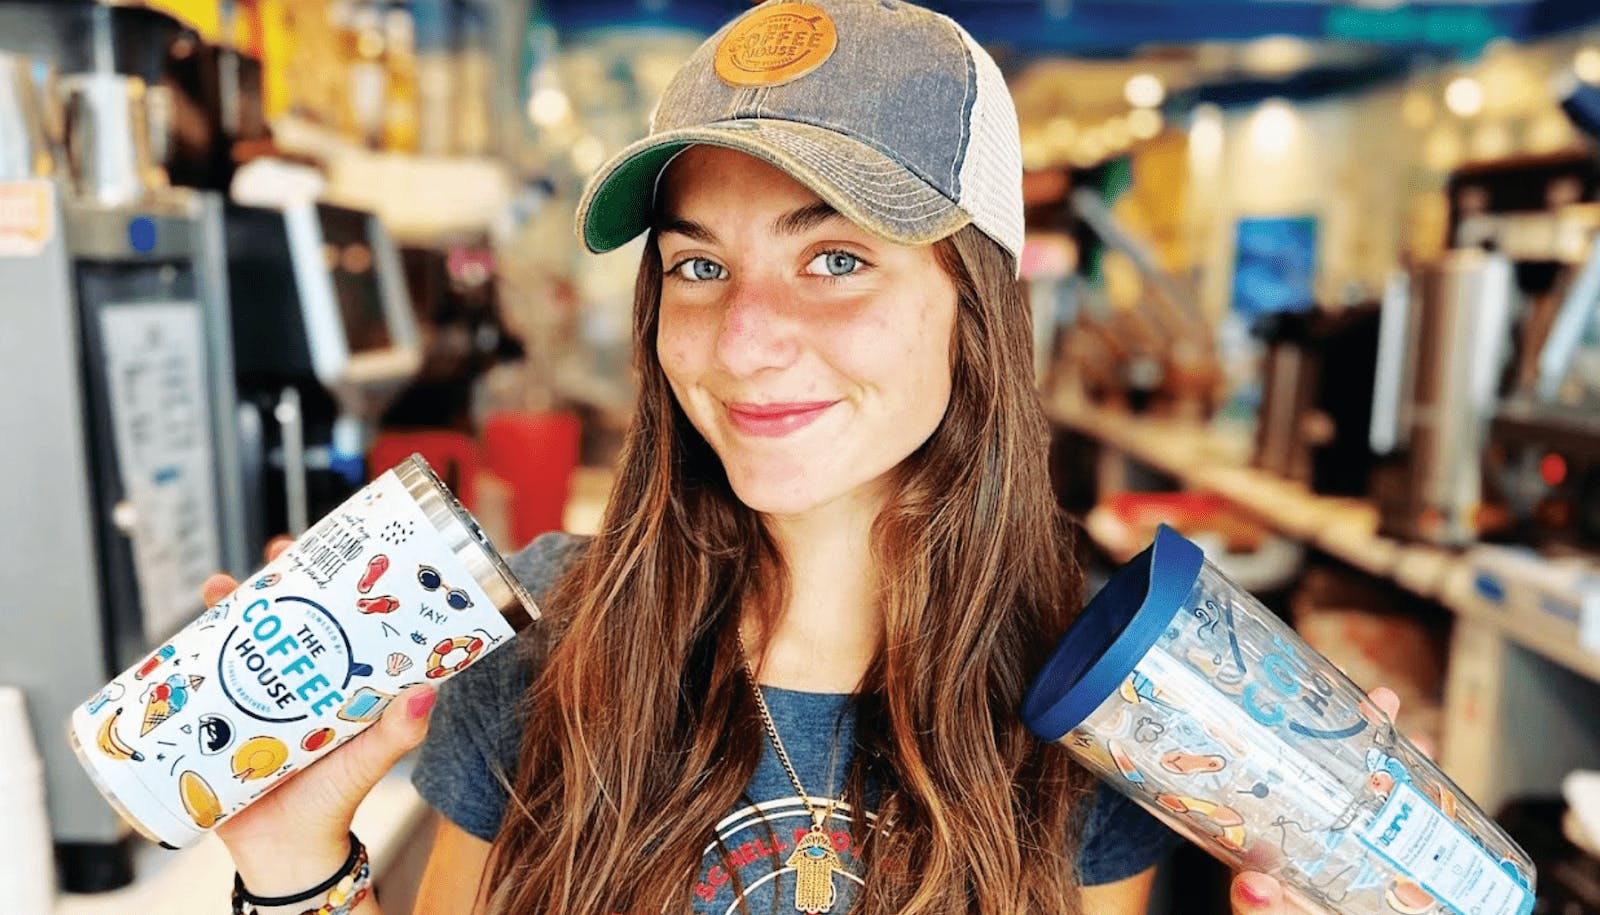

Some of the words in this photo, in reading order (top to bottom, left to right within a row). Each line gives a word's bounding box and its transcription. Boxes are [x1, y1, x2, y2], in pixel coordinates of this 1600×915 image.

[728, 30, 824, 53] COFFEE
[310, 545, 347, 579] COFFEE
[332, 532, 363, 563] SAND
[419, 603, 448, 625] YAY!
[242, 598, 344, 717] COFFEE
[297, 623, 327, 659] THE
[235, 637, 298, 710] HOUSE
[695, 832, 788, 902] SCHELL
